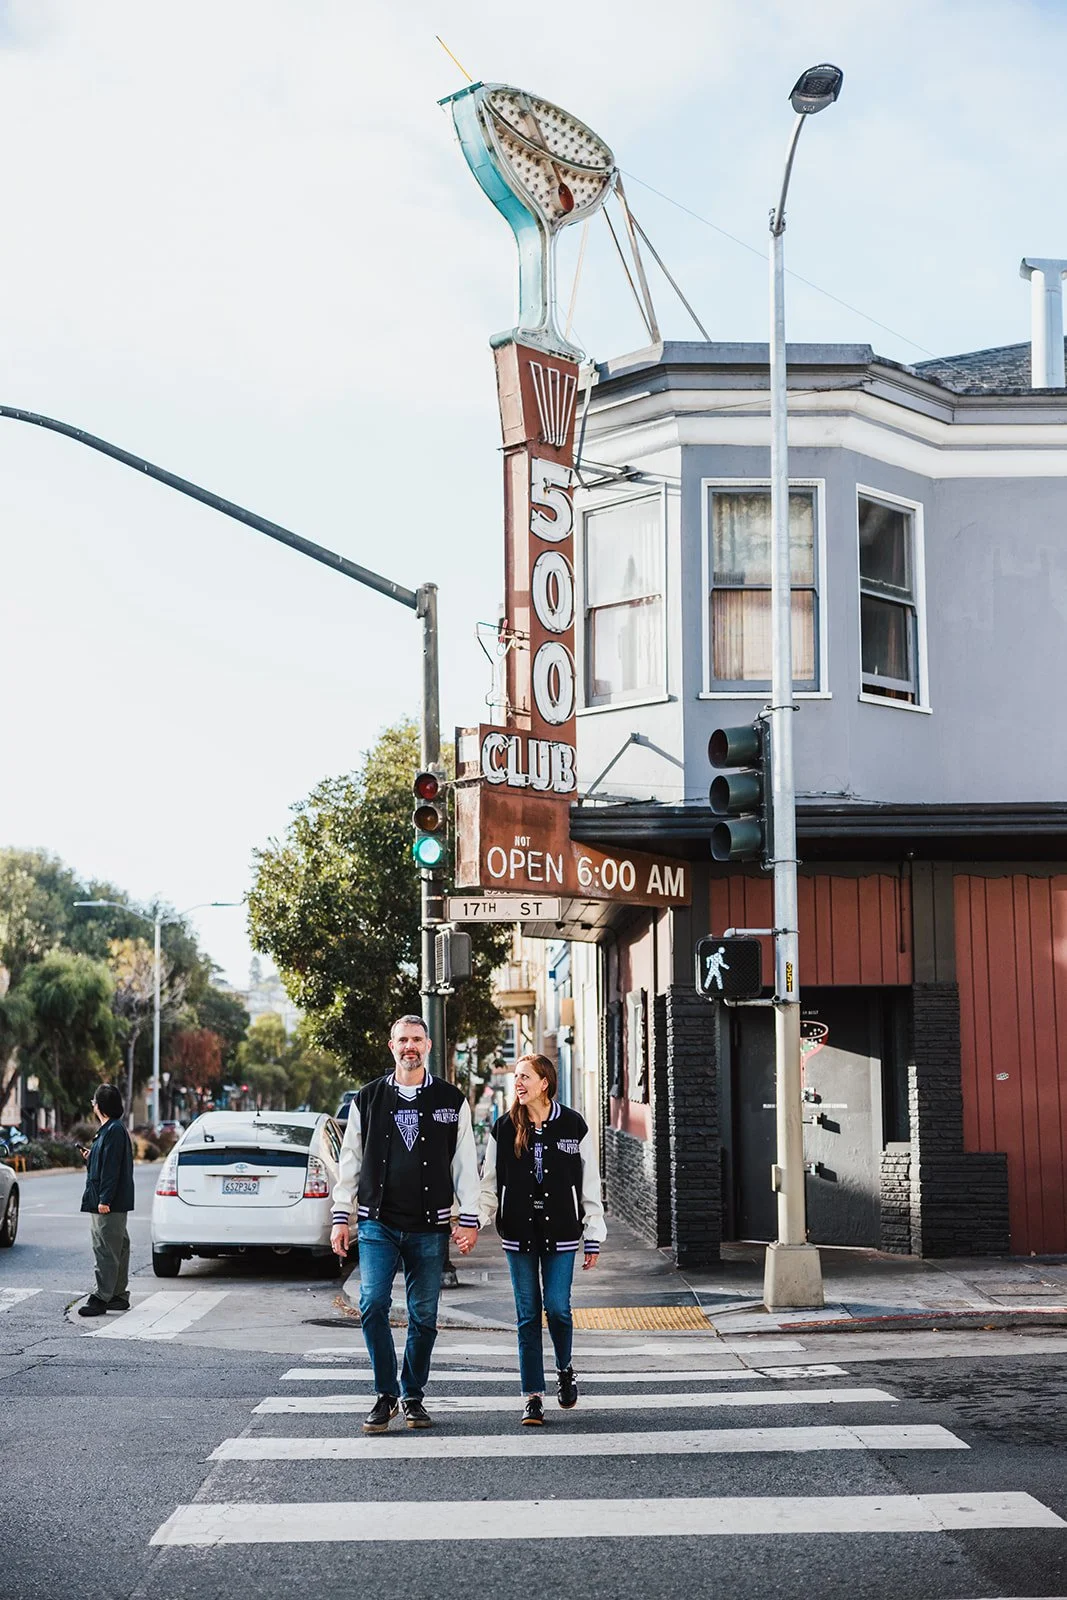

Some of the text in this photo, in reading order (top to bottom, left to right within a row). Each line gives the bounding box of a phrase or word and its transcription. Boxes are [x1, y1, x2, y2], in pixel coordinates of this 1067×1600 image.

[531, 456, 576, 726] 500
[481, 730, 577, 793] CLUB
[514, 835, 531, 847] NOT
[487, 846, 685, 898] OPEN 6:00 AM
[463, 902, 543, 916] 17TH ST
[225, 1182, 257, 1192] 6SZP349
